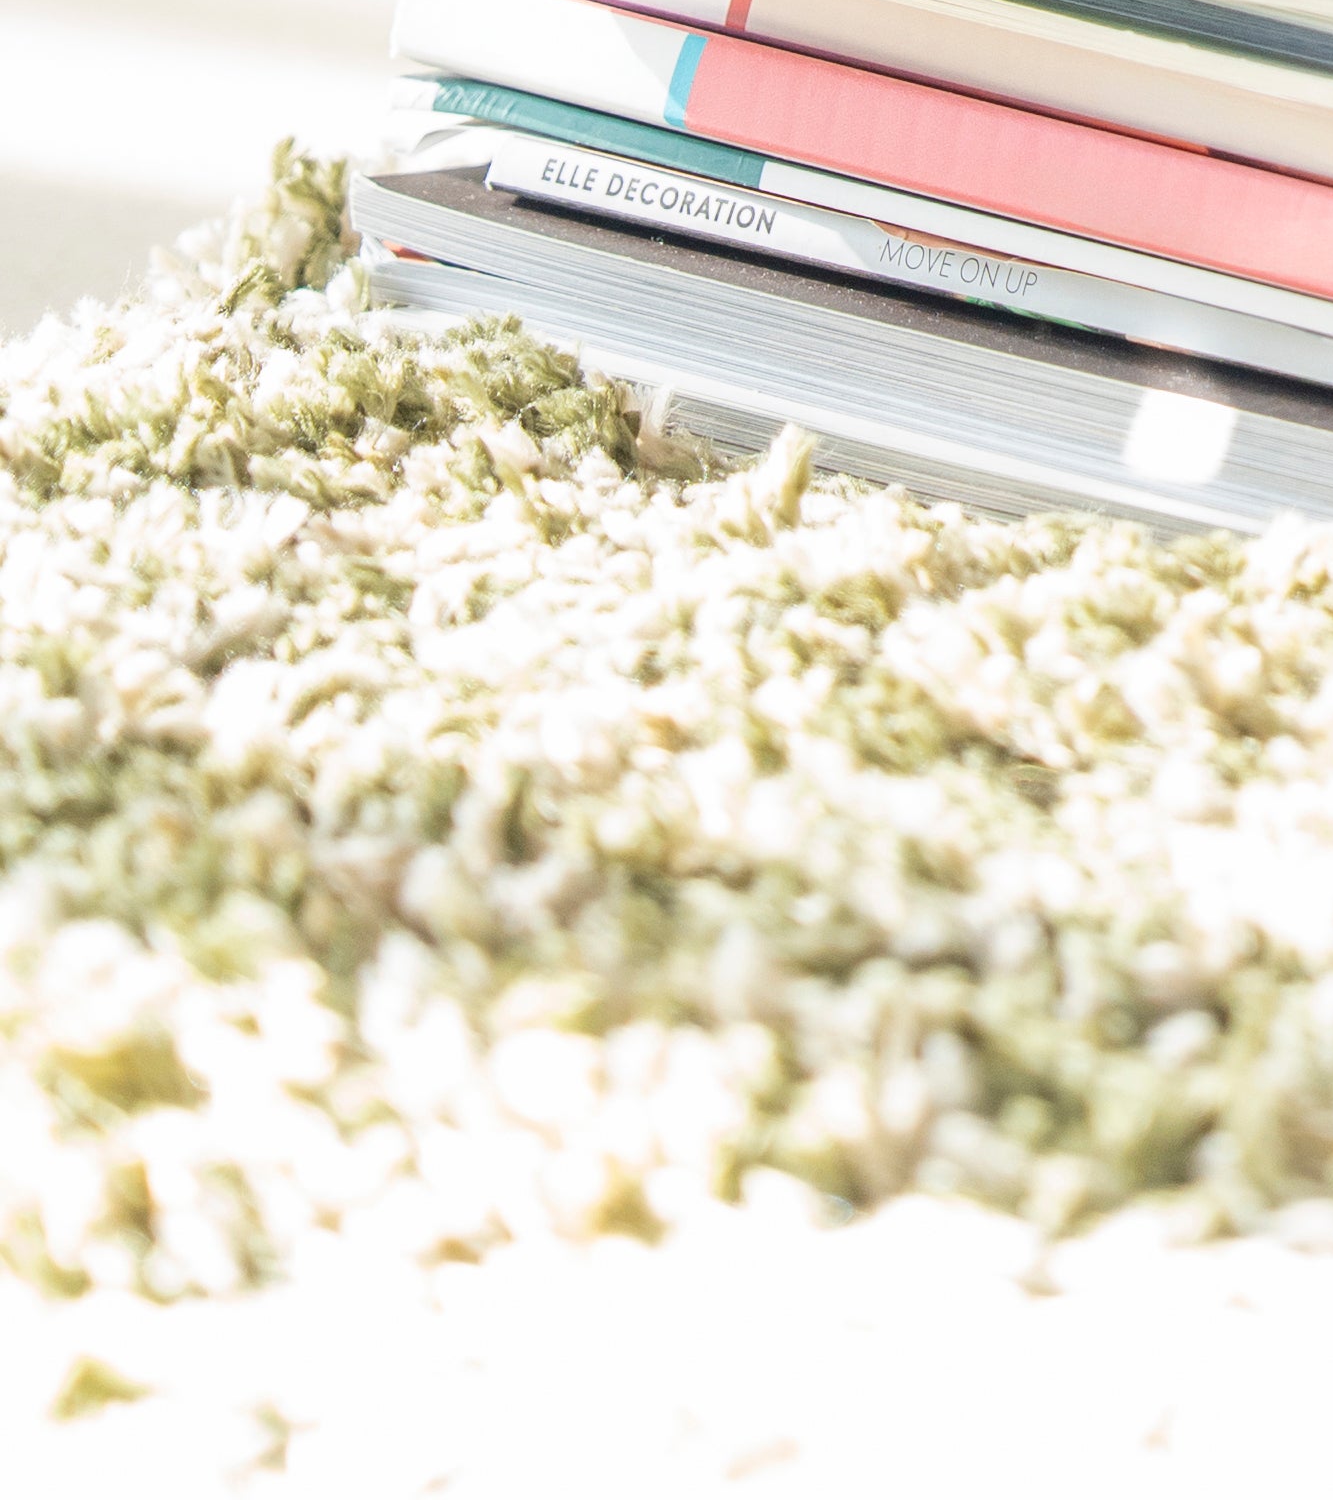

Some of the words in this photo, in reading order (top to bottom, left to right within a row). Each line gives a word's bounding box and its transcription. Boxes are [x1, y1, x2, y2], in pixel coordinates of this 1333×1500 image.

[540, 158, 599, 192] ELLE
[604, 173, 778, 235] DECORATION
[879, 238, 956, 278] MOVE
[959, 257, 1001, 289] ON
[1005, 266, 1038, 297] UP
